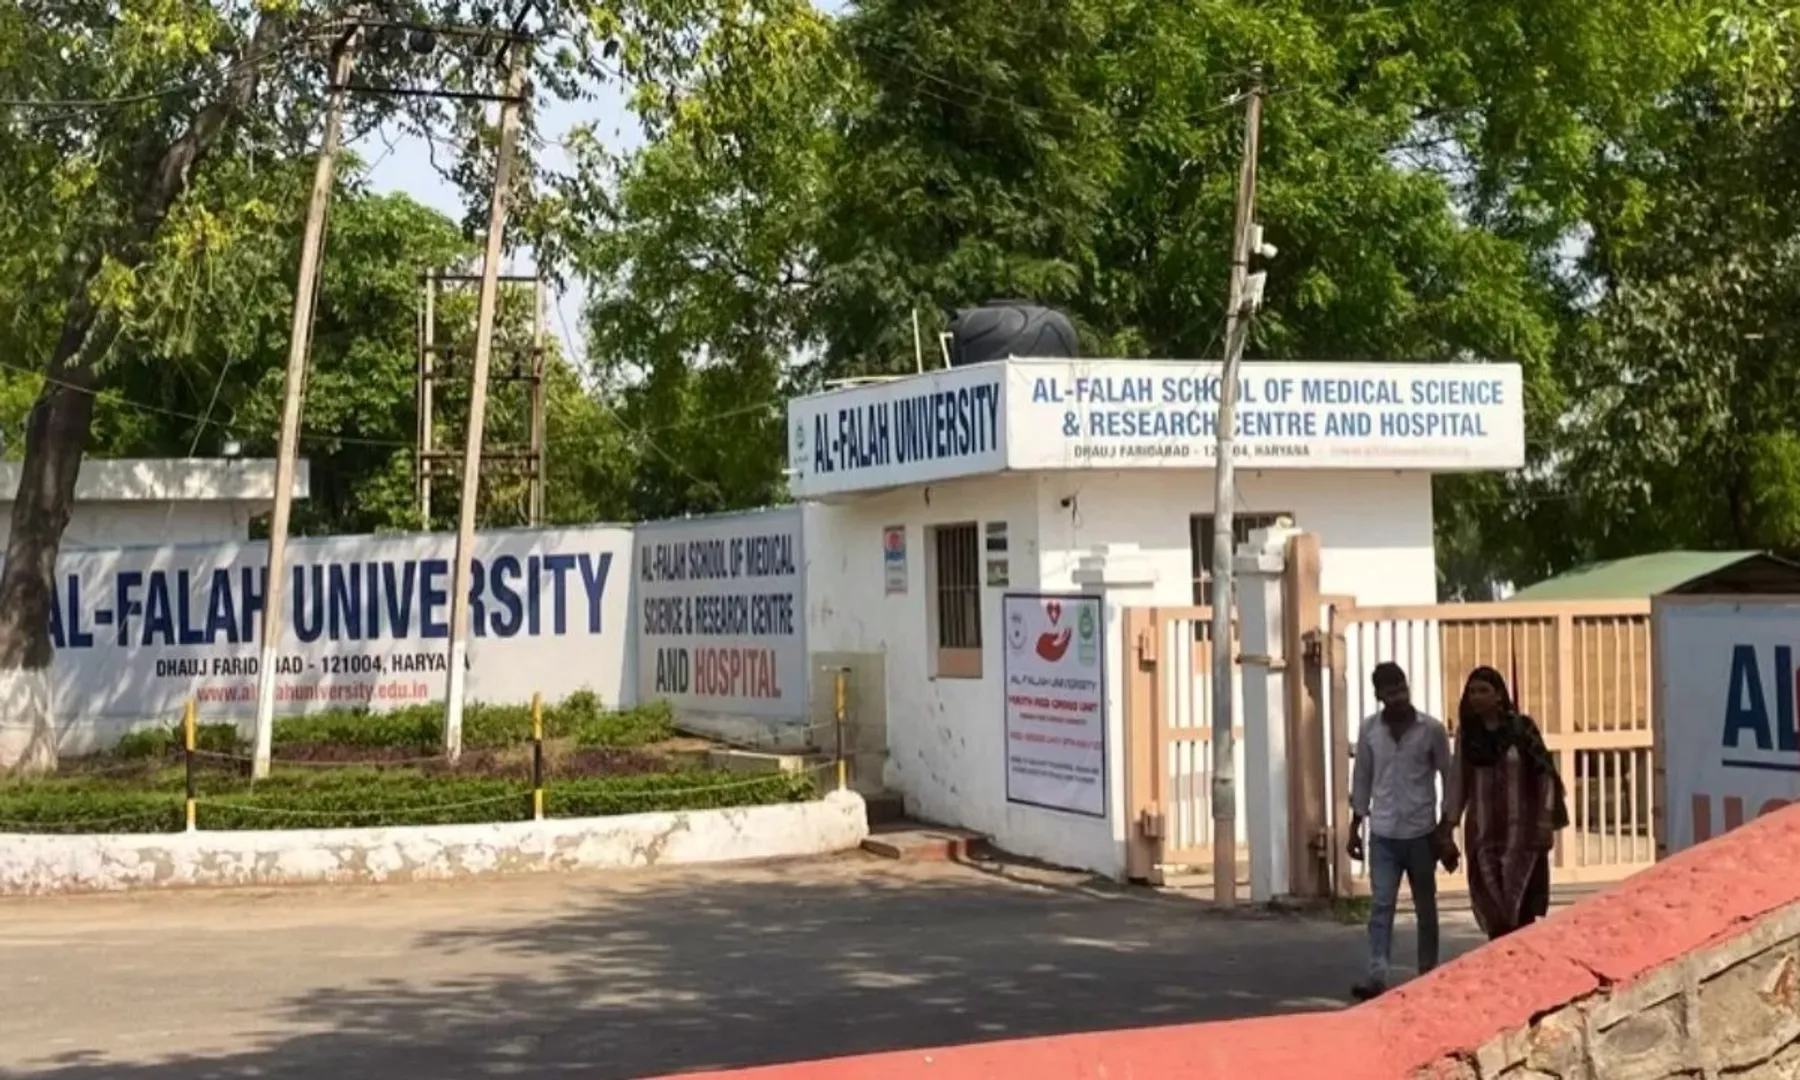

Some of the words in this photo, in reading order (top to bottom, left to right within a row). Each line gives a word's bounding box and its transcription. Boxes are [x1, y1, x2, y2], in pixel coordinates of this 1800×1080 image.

[1032, 377, 1153, 403] AL-FALAH
[1161, 377, 1257, 404] SCHOL
[1264, 377, 1293, 403] OF
[1301, 378, 1404, 405] MEDICAL
[1411, 379, 1503, 405] SCIENCE
[814, 402, 890, 474] AL-FALAH
[894, 383, 999, 464] UNIVERSITY
[1062, 411, 1080, 436] &
[1089, 410, 1217, 437] RESEARCH
[1324, 411, 1371, 437] AND
[1380, 411, 1487, 437] HOSPITAL
[1074, 444, 1115, 458] DHAUJ
[1119, 444, 1190, 458] FARIDABAD
[1204, 444, 1251, 459] 1204,
[1254, 444, 1310, 458] HARYANA
[642, 541, 687, 582] AL-FALAH
[689, 539, 728, 580] SCHOOL
[730, 537, 744, 579] OF
[746, 533, 795, 577] MEDICAL
[643, 596, 683, 636] SCIENCE
[685, 596, 693, 635] &
[695, 594, 749, 636] RESEARCH
[751, 592, 794, 636] CENTRE
[156, 658, 207, 678] DHAUJ
[212, 656, 303, 676] FARIDAD
[322, 653, 387, 677] 121004,
[391, 652, 471, 673] HARYA
[655, 647, 689, 693] AND
[694, 647, 782, 699] HOSPITAL
